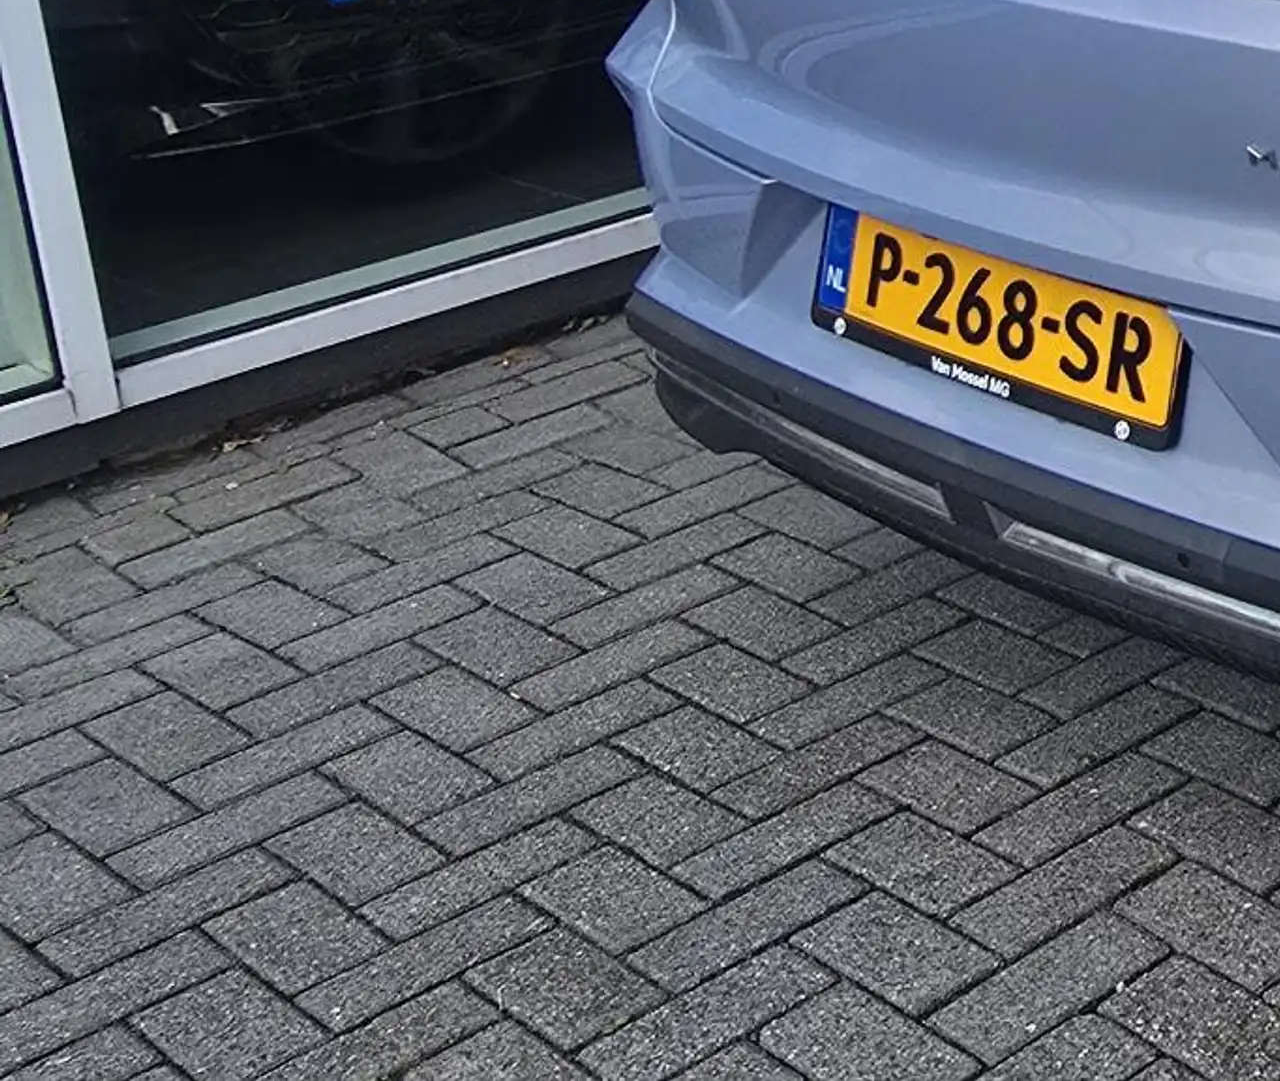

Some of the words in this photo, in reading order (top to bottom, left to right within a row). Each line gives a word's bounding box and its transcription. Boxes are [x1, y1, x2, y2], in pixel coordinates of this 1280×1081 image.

[826, 264, 846, 294] NL
[866, 231, 1153, 403] P-268-SR
[931, 355, 950, 376] Van
[988, 377, 1010, 398] MG
